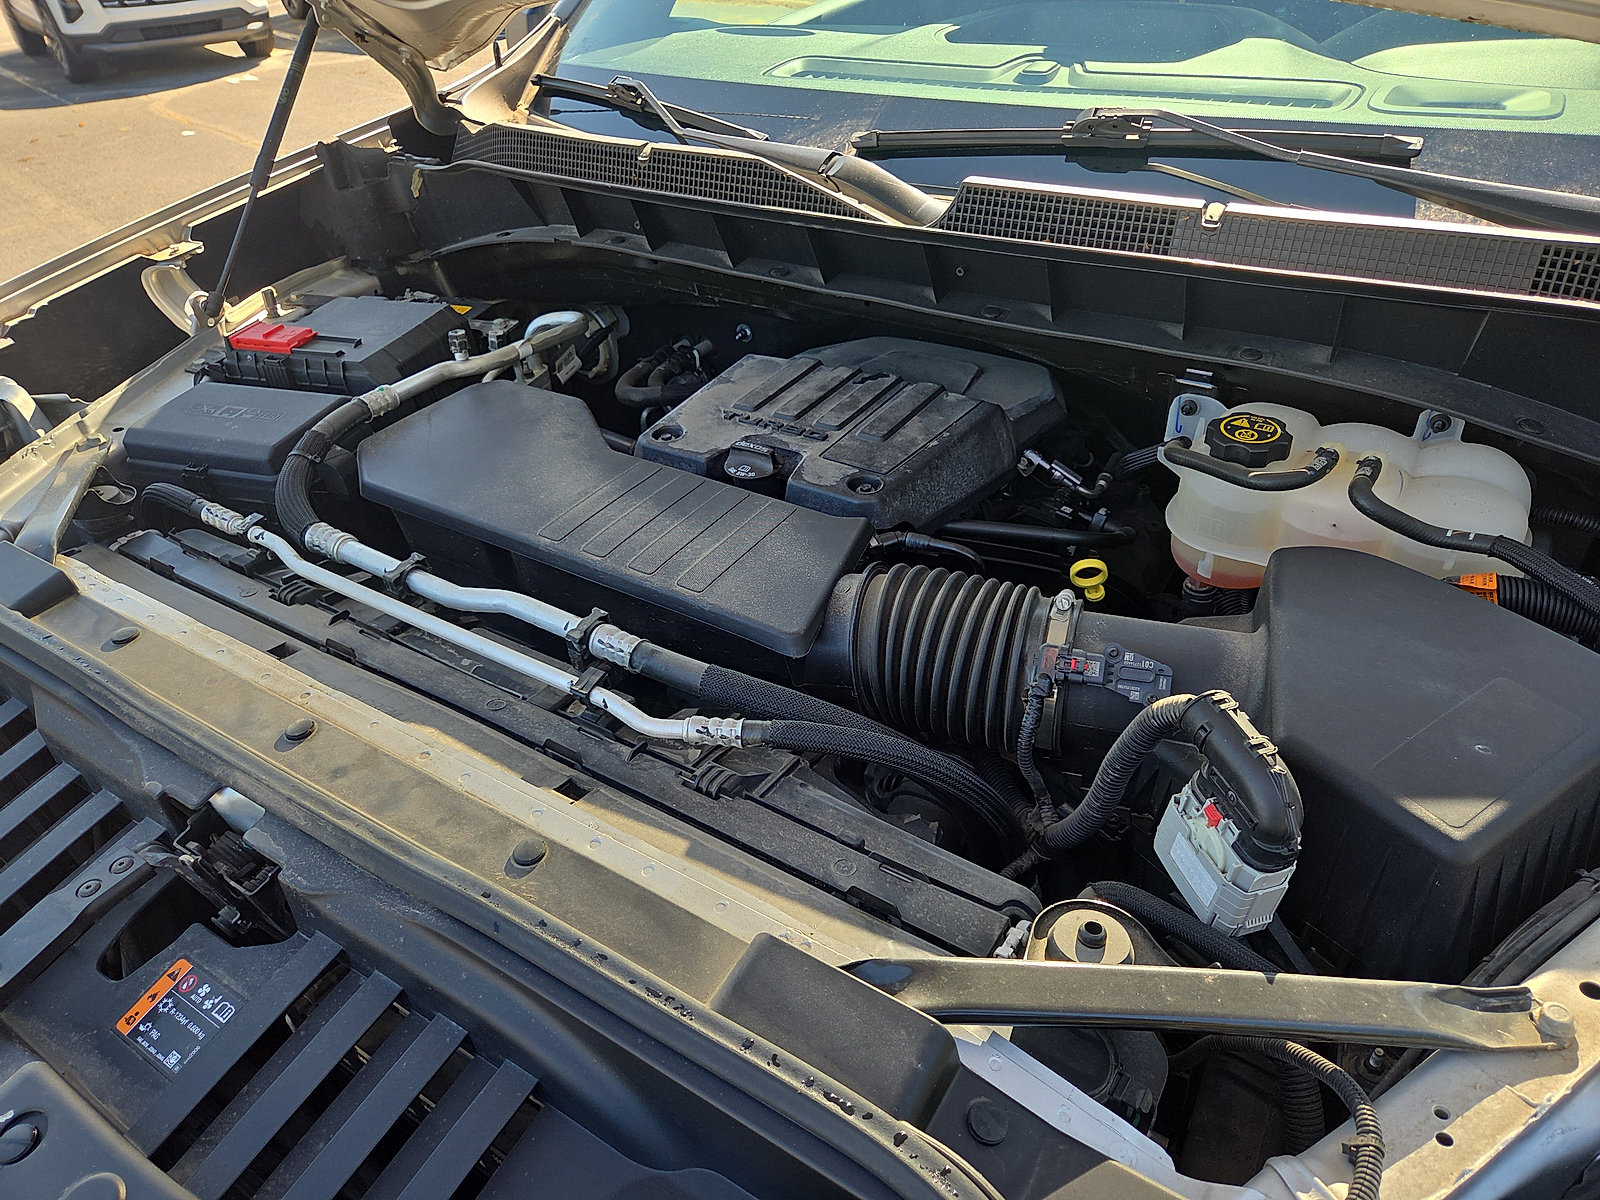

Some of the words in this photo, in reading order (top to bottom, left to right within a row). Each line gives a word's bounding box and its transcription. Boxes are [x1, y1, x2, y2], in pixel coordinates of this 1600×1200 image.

[719, 407, 829, 441] TURBO
[735, 441, 770, 452] dexos
[1124, 652, 1134, 661] GM
[190, 994, 202, 1004] AUTO
[149, 1028, 161, 1041] PAG
[198, 1030, 206, 1041] kg
